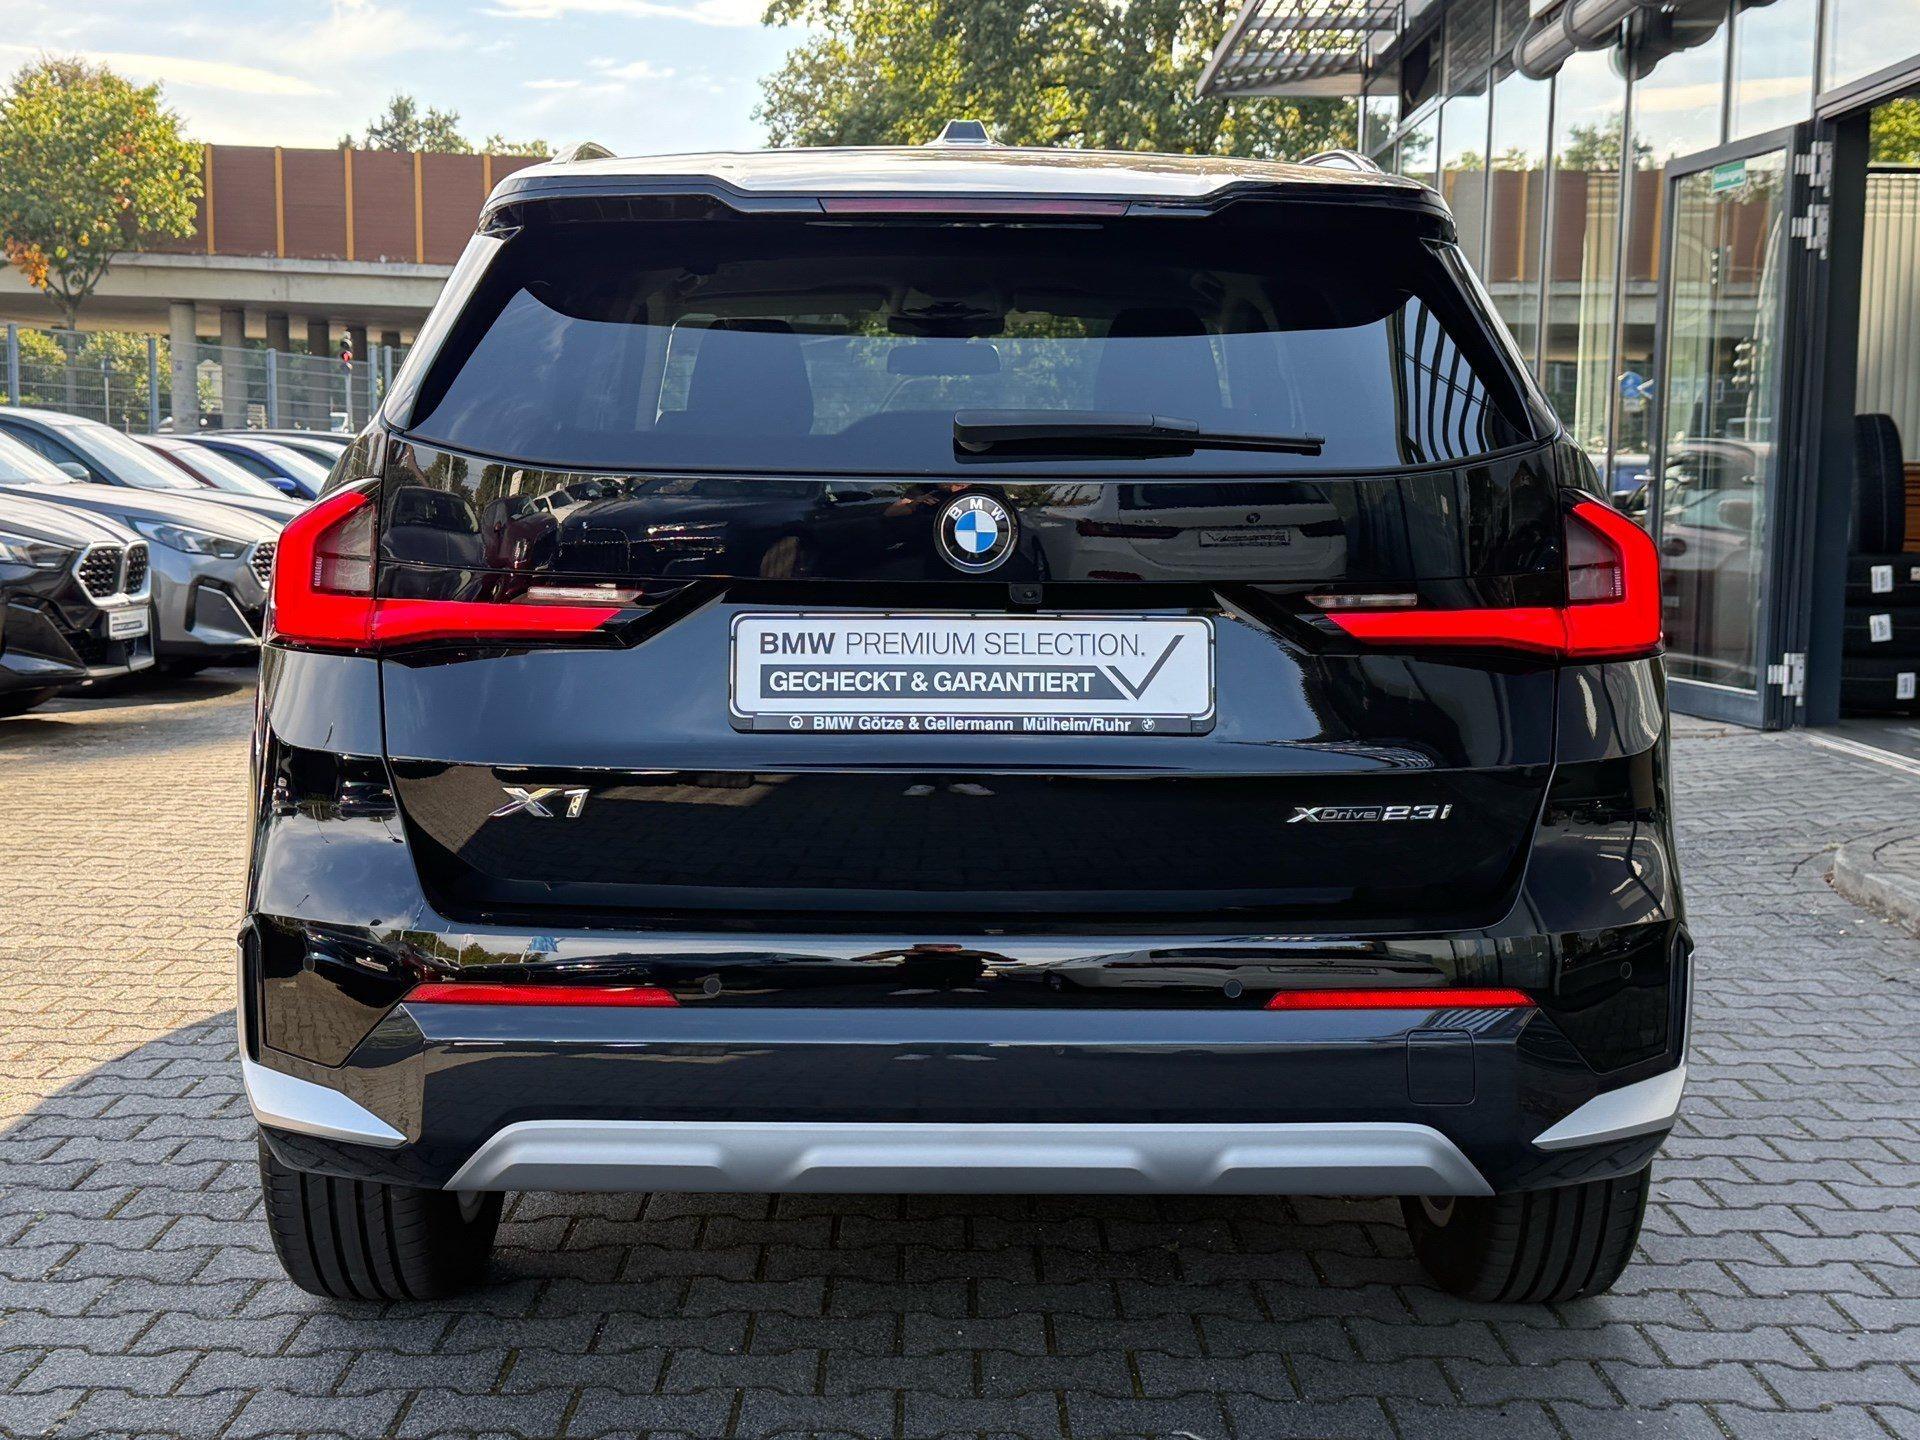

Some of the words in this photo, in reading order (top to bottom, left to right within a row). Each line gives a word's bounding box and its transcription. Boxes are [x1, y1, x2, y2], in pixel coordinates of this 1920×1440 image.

[948, 498, 1005, 521] BMW
[759, 632, 836, 655] BMW
[845, 632, 975, 655] PREMIUM
[984, 632, 1146, 657] SELECTION.
[769, 670, 908, 692] GECHECKT
[910, 672, 929, 692] &
[932, 672, 1096, 693] GARANTIERT
[813, 716, 853, 729] BMW
[858, 715, 904, 731] Götze
[909, 717, 920, 730] &
[924, 716, 1014, 731] Gellermann
[1022, 717, 1132, 732] Mülheim/Ruhr
[489, 787, 590, 818] X1
